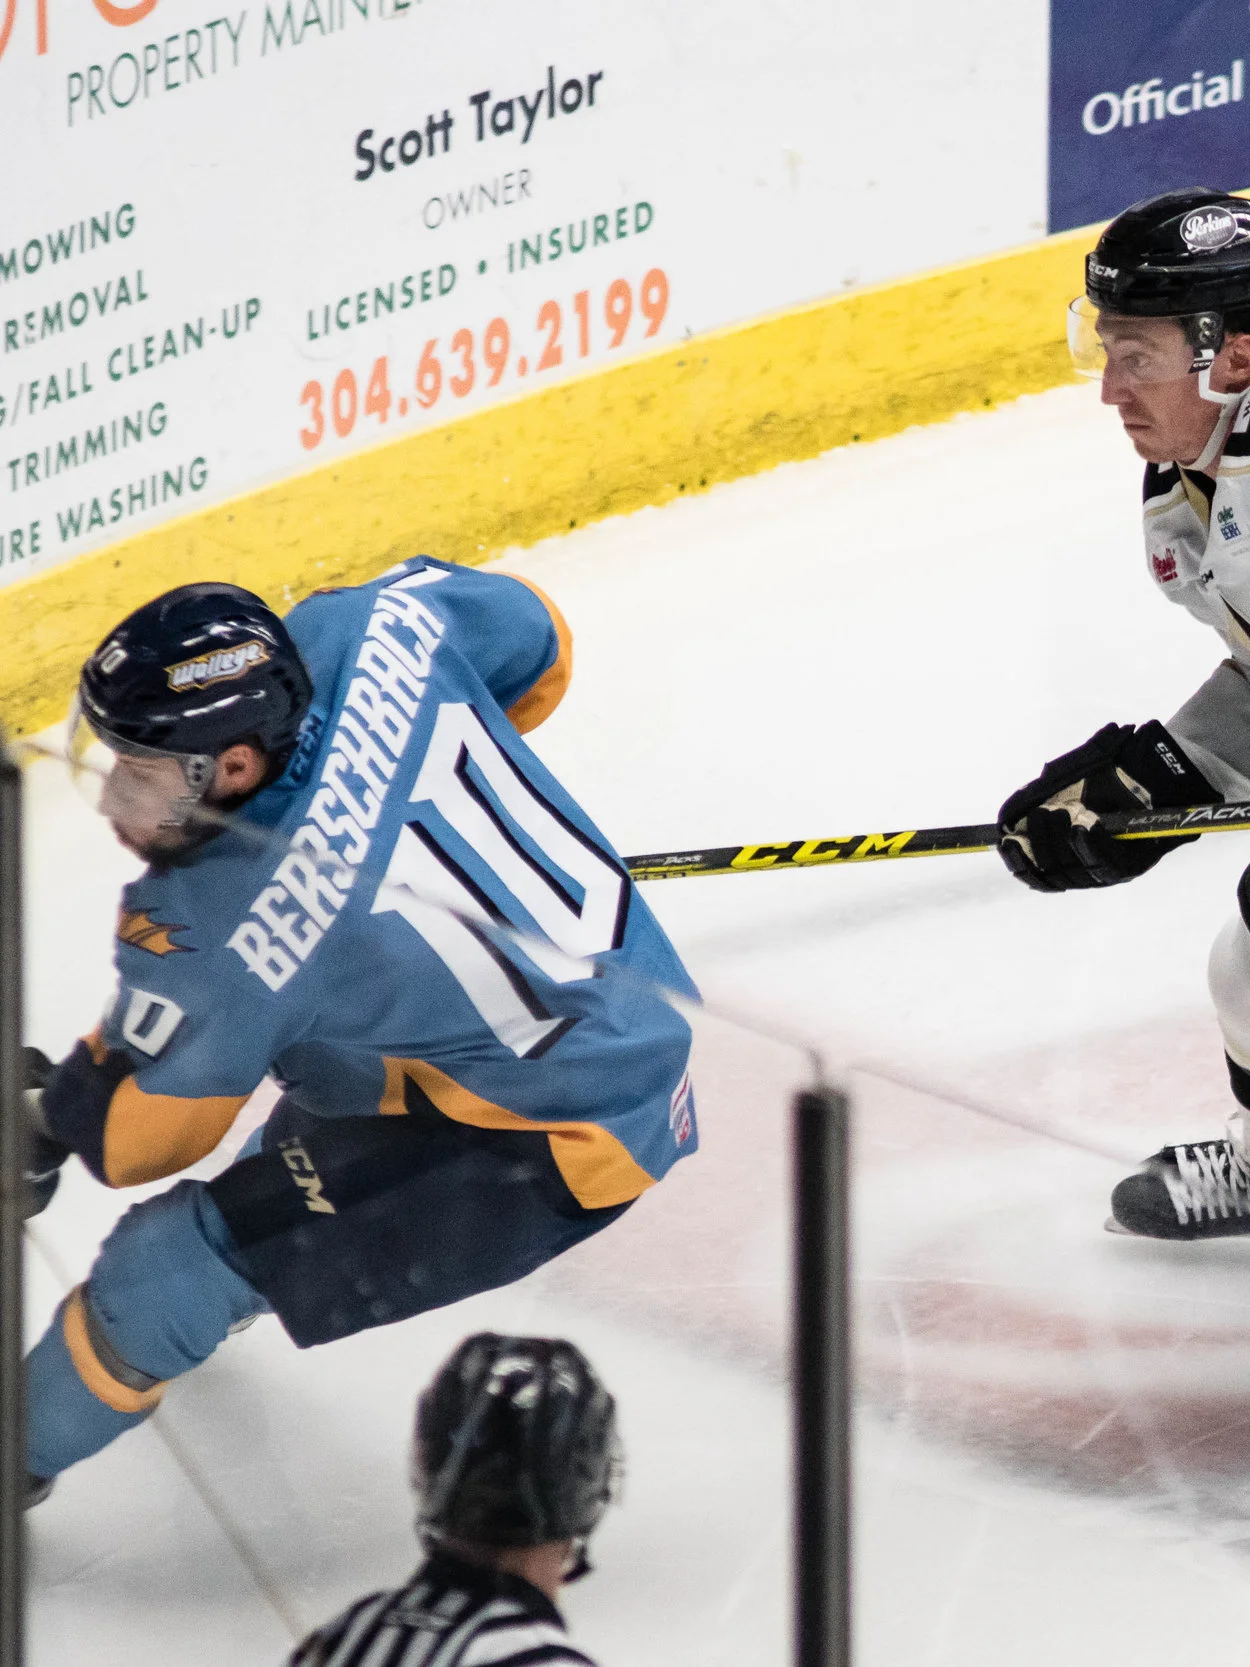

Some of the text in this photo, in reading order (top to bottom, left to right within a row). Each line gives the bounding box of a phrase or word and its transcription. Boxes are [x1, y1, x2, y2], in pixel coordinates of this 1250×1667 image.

[66, 10, 247, 128] PROPERTY
[1082, 59, 1244, 136] Official
[354, 64, 604, 182] Scott Taylor
[0, 203, 136, 284] MOWING
[422, 168, 532, 230] OWNER
[4, 269, 149, 354] REMOVAL
[306, 201, 655, 342] LICENSED INSURED
[107, 297, 262, 382] CLEAN-UP
[300, 267, 670, 452] 304.639.2199
[8, 401, 168, 493] TRIMMING
[0, 456, 208, 568] RE WASHING
[225, 587, 446, 993] BERSCHBACH
[369, 701, 632, 1061] 10
[730, 830, 918, 868] CCM
[277, 1136, 337, 1215] CM
